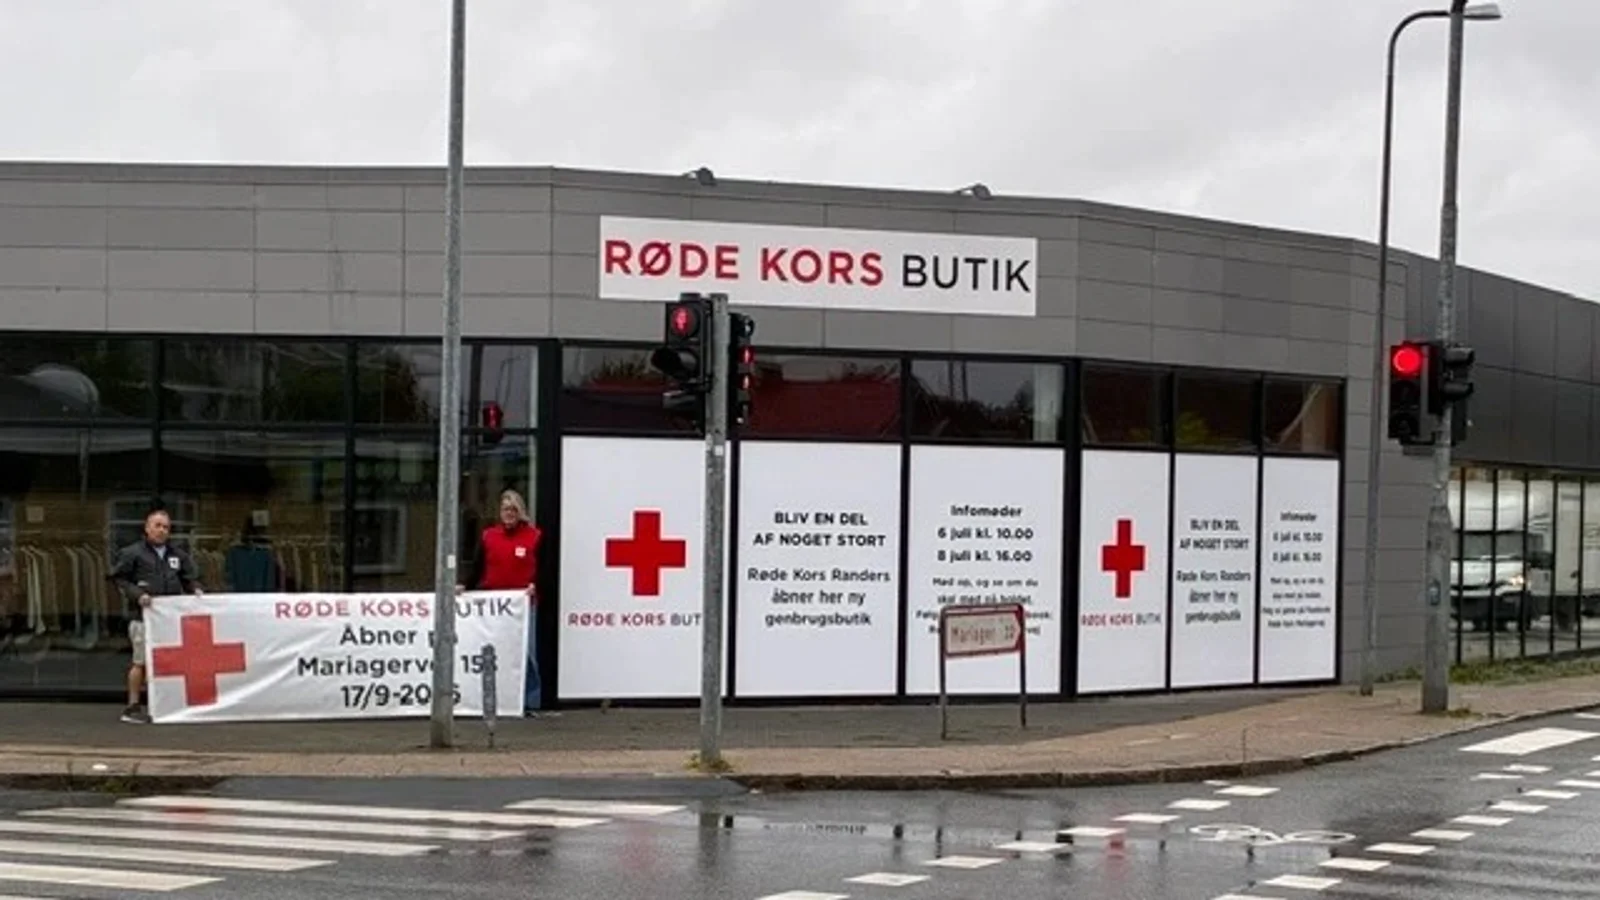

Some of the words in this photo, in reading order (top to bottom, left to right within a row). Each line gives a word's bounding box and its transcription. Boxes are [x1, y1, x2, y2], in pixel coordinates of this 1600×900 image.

[605, 240, 740, 280] RØDE
[760, 247, 884, 287] KORS
[902, 254, 1031, 293] BUTIK
[774, 512, 809, 524] BLIV
[814, 512, 835, 525] EN
[839, 513, 868, 526] DEL
[753, 533, 775, 546] AF
[780, 533, 832, 546] NOGET
[837, 534, 886, 547] STORT
[937, 527, 946, 539] 6
[950, 527, 971, 541] juli
[975, 527, 992, 539] kl.
[997, 527, 1034, 540] 10.00
[950, 550, 971, 563] juli
[996, 550, 1033, 562] 16.00
[747, 568, 788, 581] Røde
[793, 568, 826, 581] Kors
[832, 568, 891, 581] Randers
[771, 587, 814, 604] åbner
[819, 589, 844, 604] her
[848, 591, 866, 606] ny
[275, 600, 350, 618] RØDE
[361, 599, 430, 618] KORS
[455, 597, 513, 618] UTIK
[567, 612, 616, 626] RØDE
[620, 612, 666, 626] KORS
[670, 612, 702, 626] BUT
[764, 611, 872, 628] genbrugsbutik
[340, 622, 417, 646] Åbner
[298, 655, 434, 679] Mariagerv
